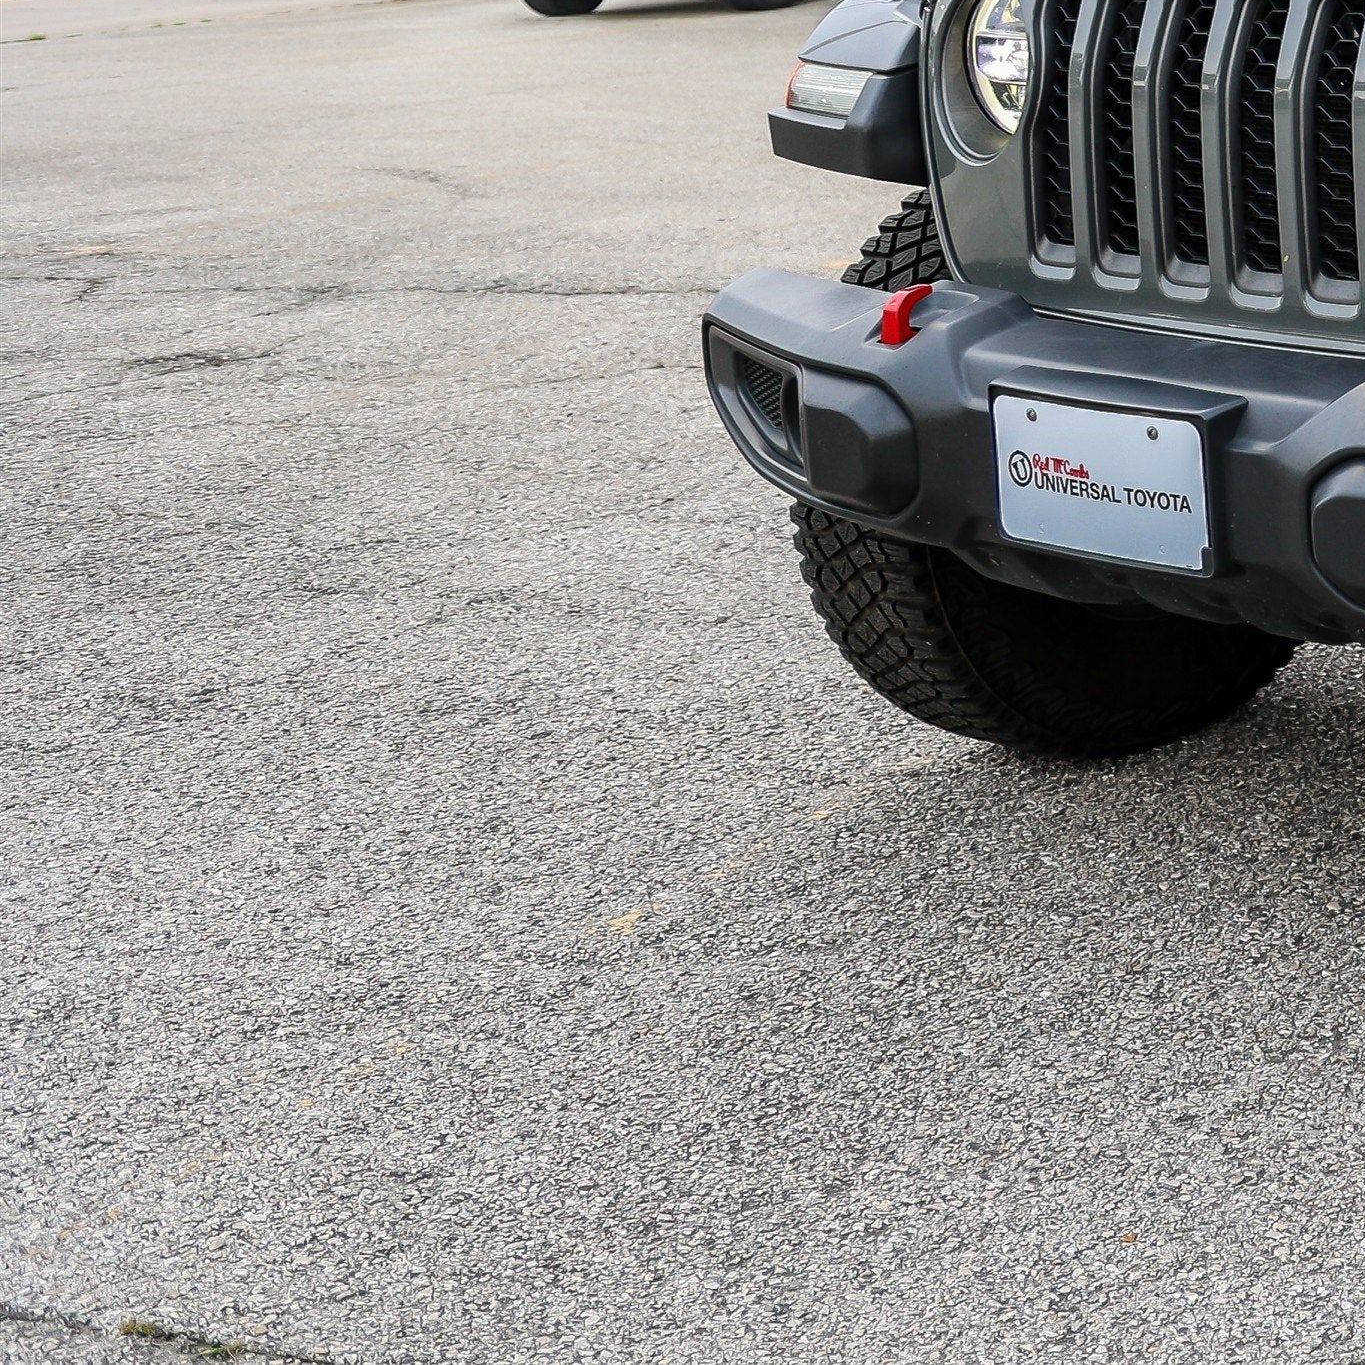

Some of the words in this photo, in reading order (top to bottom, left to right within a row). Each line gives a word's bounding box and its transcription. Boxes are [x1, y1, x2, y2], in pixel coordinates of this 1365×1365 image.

[1032, 453, 1050, 474] Red
[1050, 456, 1090, 480] McCombs
[1034, 471, 1121, 504] UNIVERSAL
[1123, 487, 1193, 514] TOYOTA
